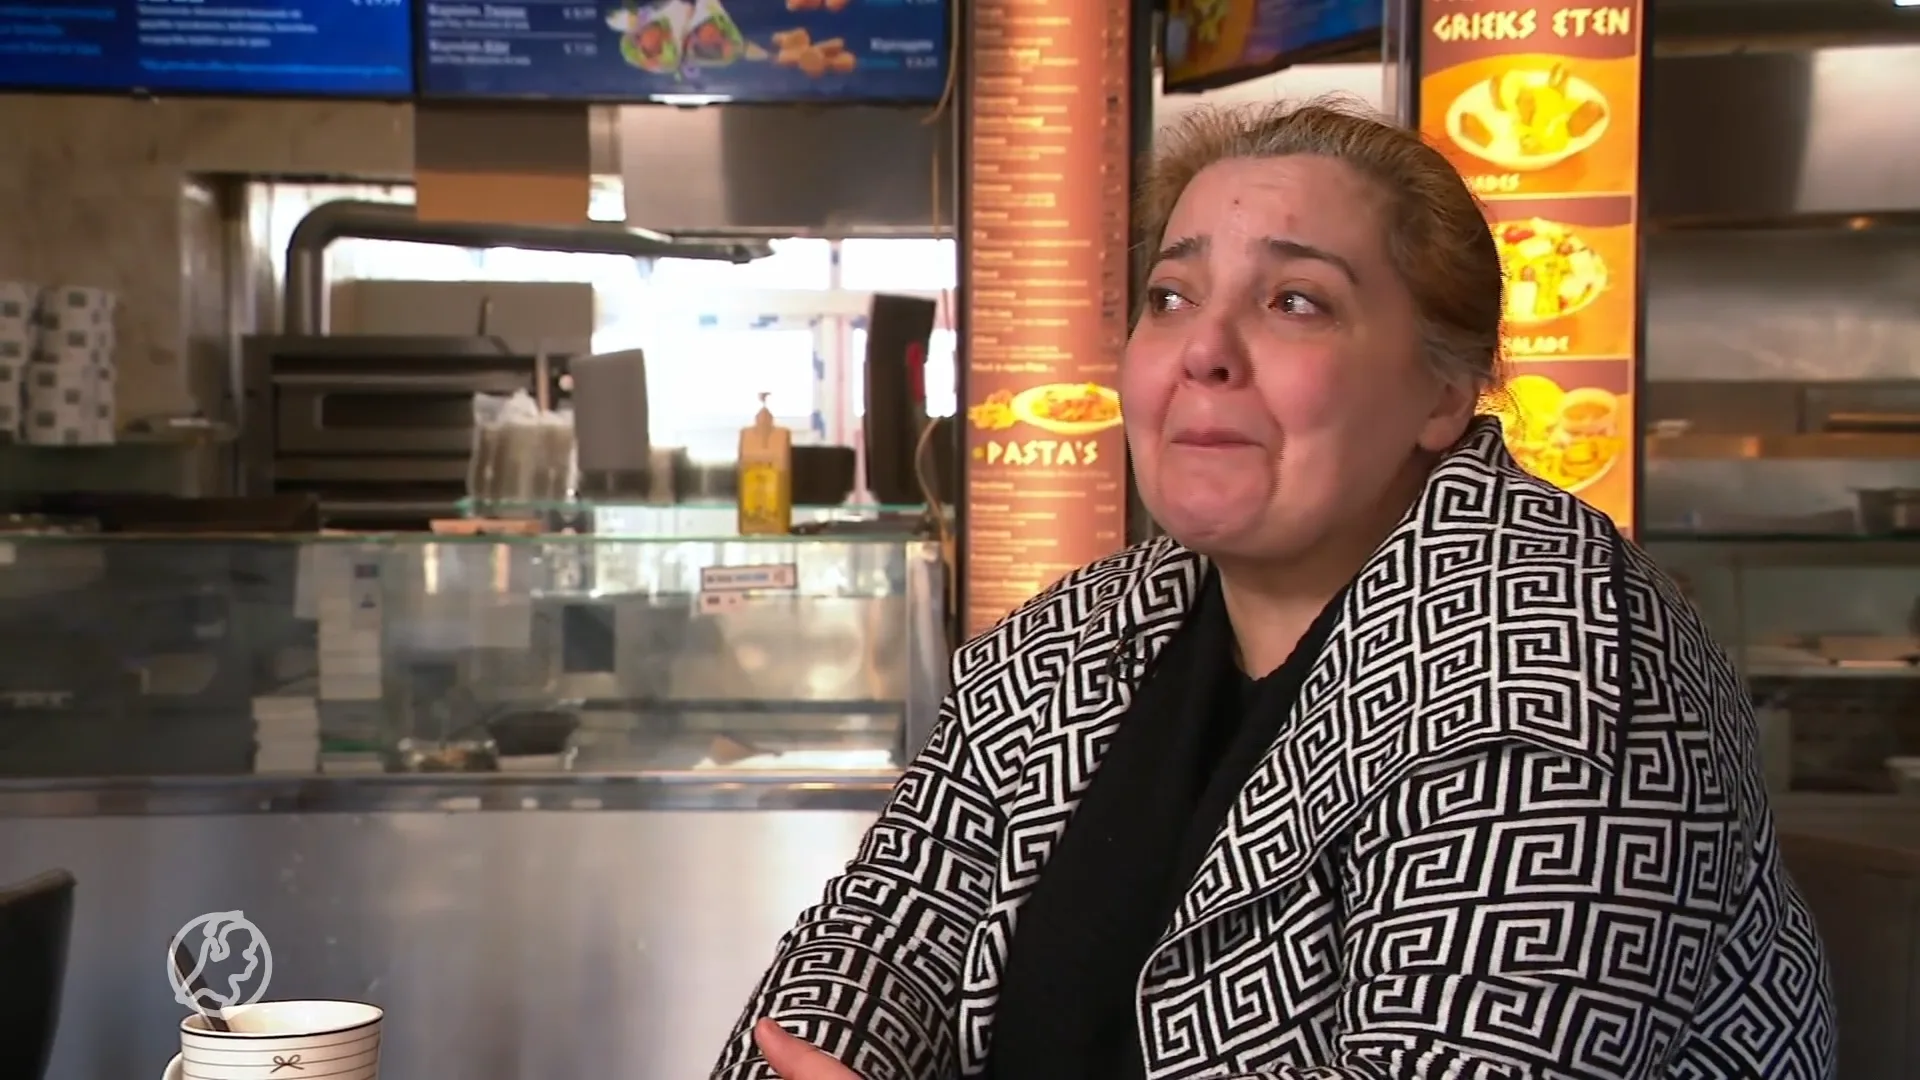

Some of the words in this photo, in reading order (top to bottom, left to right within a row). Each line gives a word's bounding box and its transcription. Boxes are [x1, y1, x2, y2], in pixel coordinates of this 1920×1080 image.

[1433, 8, 1537, 42] GRIEKS
[1552, 7, 1631, 37] ETEN
[1464, 173, 1520, 192] ADES
[986, 440, 1099, 466] PASTA'S
